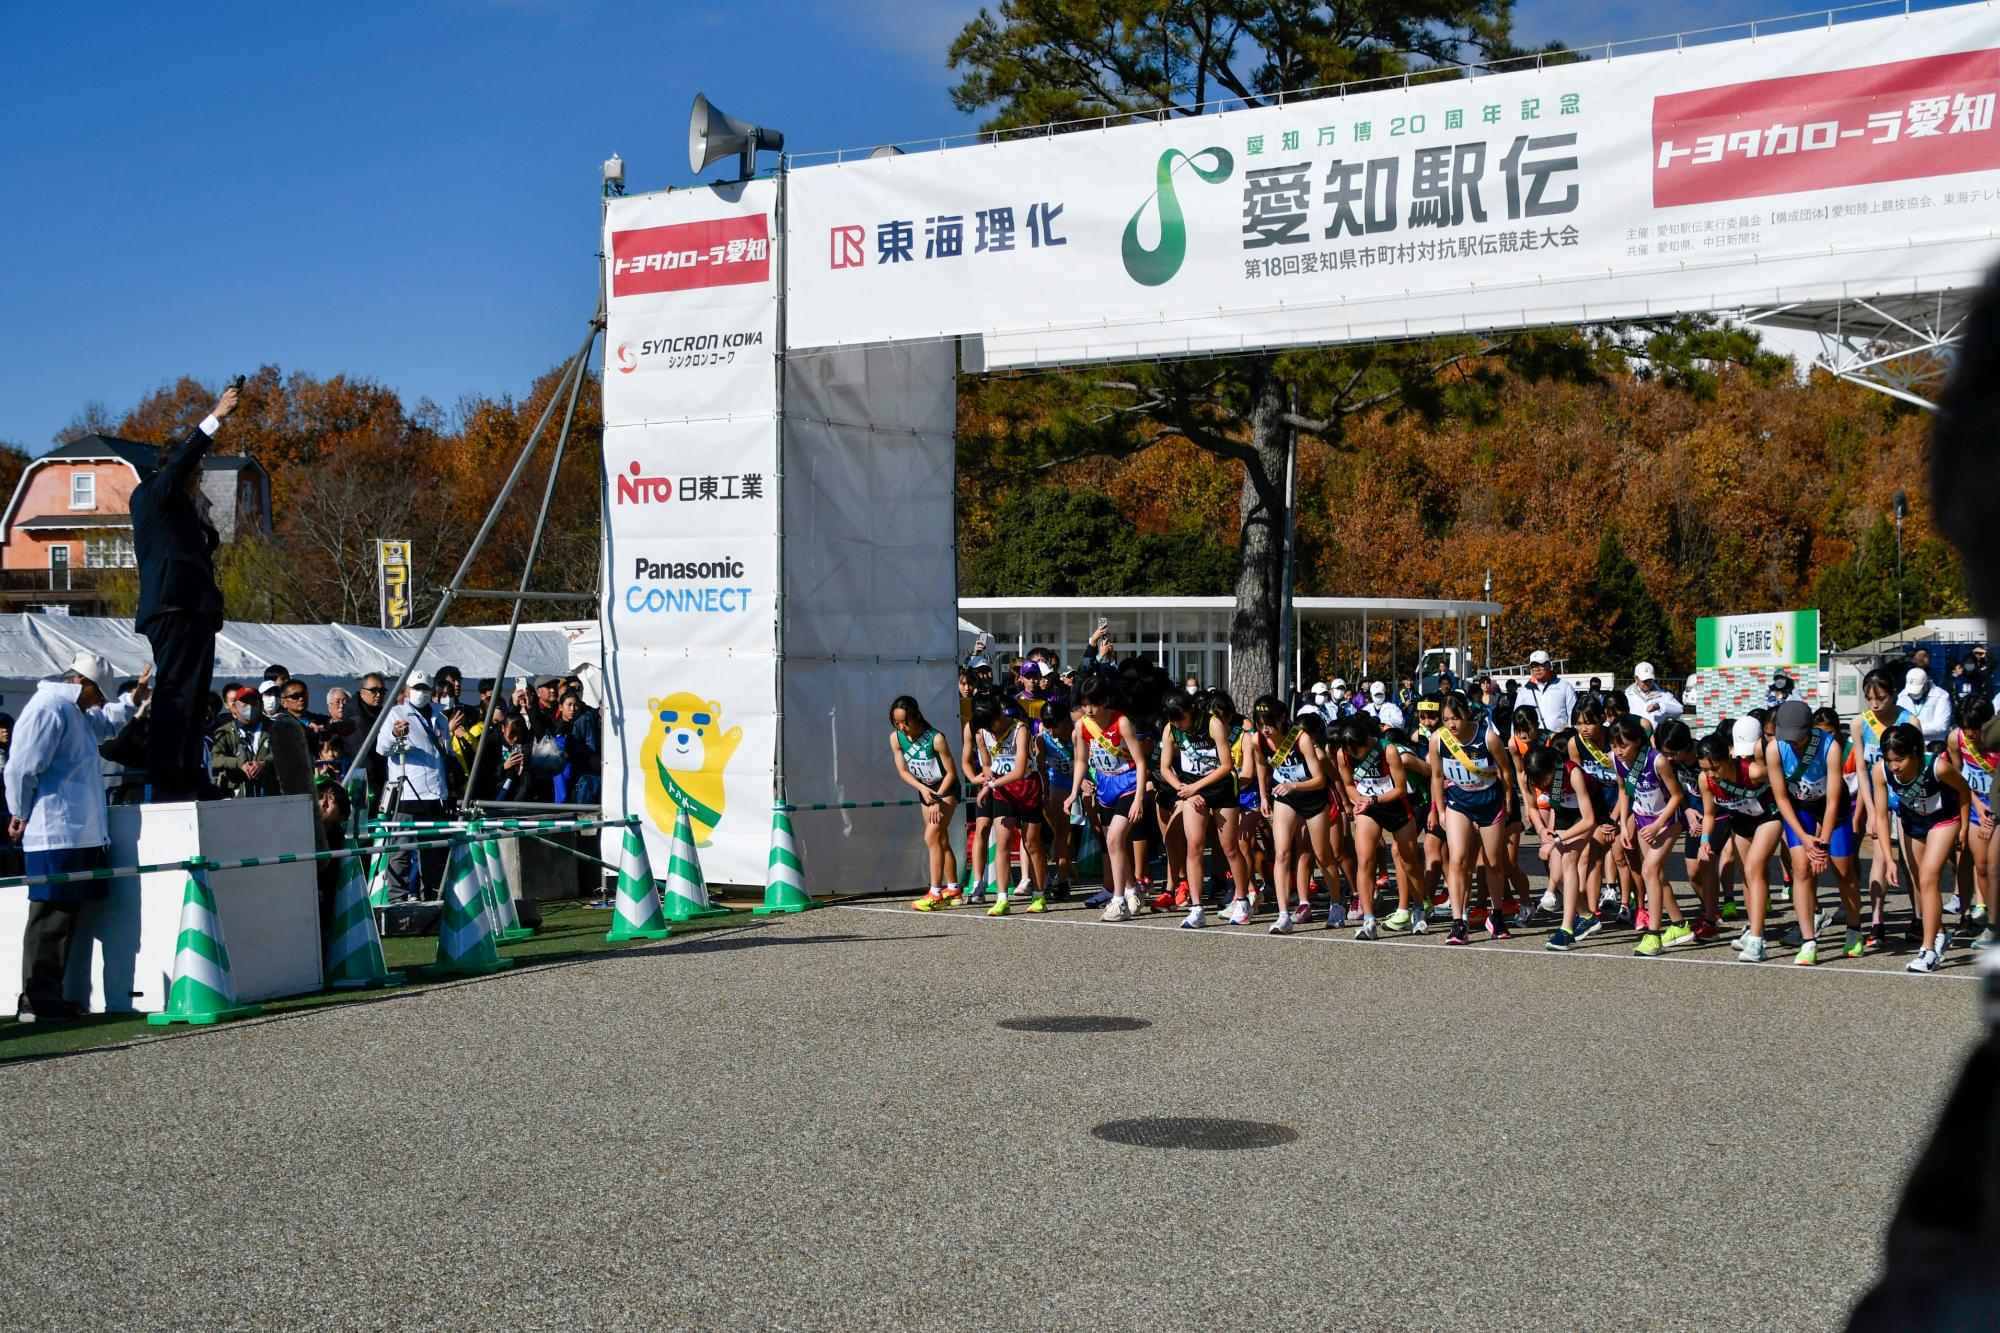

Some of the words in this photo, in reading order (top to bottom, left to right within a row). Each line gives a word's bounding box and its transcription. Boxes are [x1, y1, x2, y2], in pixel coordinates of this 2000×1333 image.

[1246, 92, 1581, 157] 愛知万博20周年記念
[1657, 92, 1996, 169] トヨタカローラ愛知
[1243, 132, 1580, 250] 愛知駅伝
[877, 202, 1067, 265] 東海理化
[1245, 224, 1580, 280] 第18回愛知県市町村対抗駅伝競走大会
[614, 238, 767, 275] トヨタカローラ愛知
[641, 334, 719, 355] SYNCRON
[723, 331, 763, 347] KOWA
[679, 472, 763, 502] 日東工業
[635, 556, 744, 579] Panasonic
[626, 585, 752, 613] CONNECT
[1738, 630, 1771, 651] 愛知駅伝
